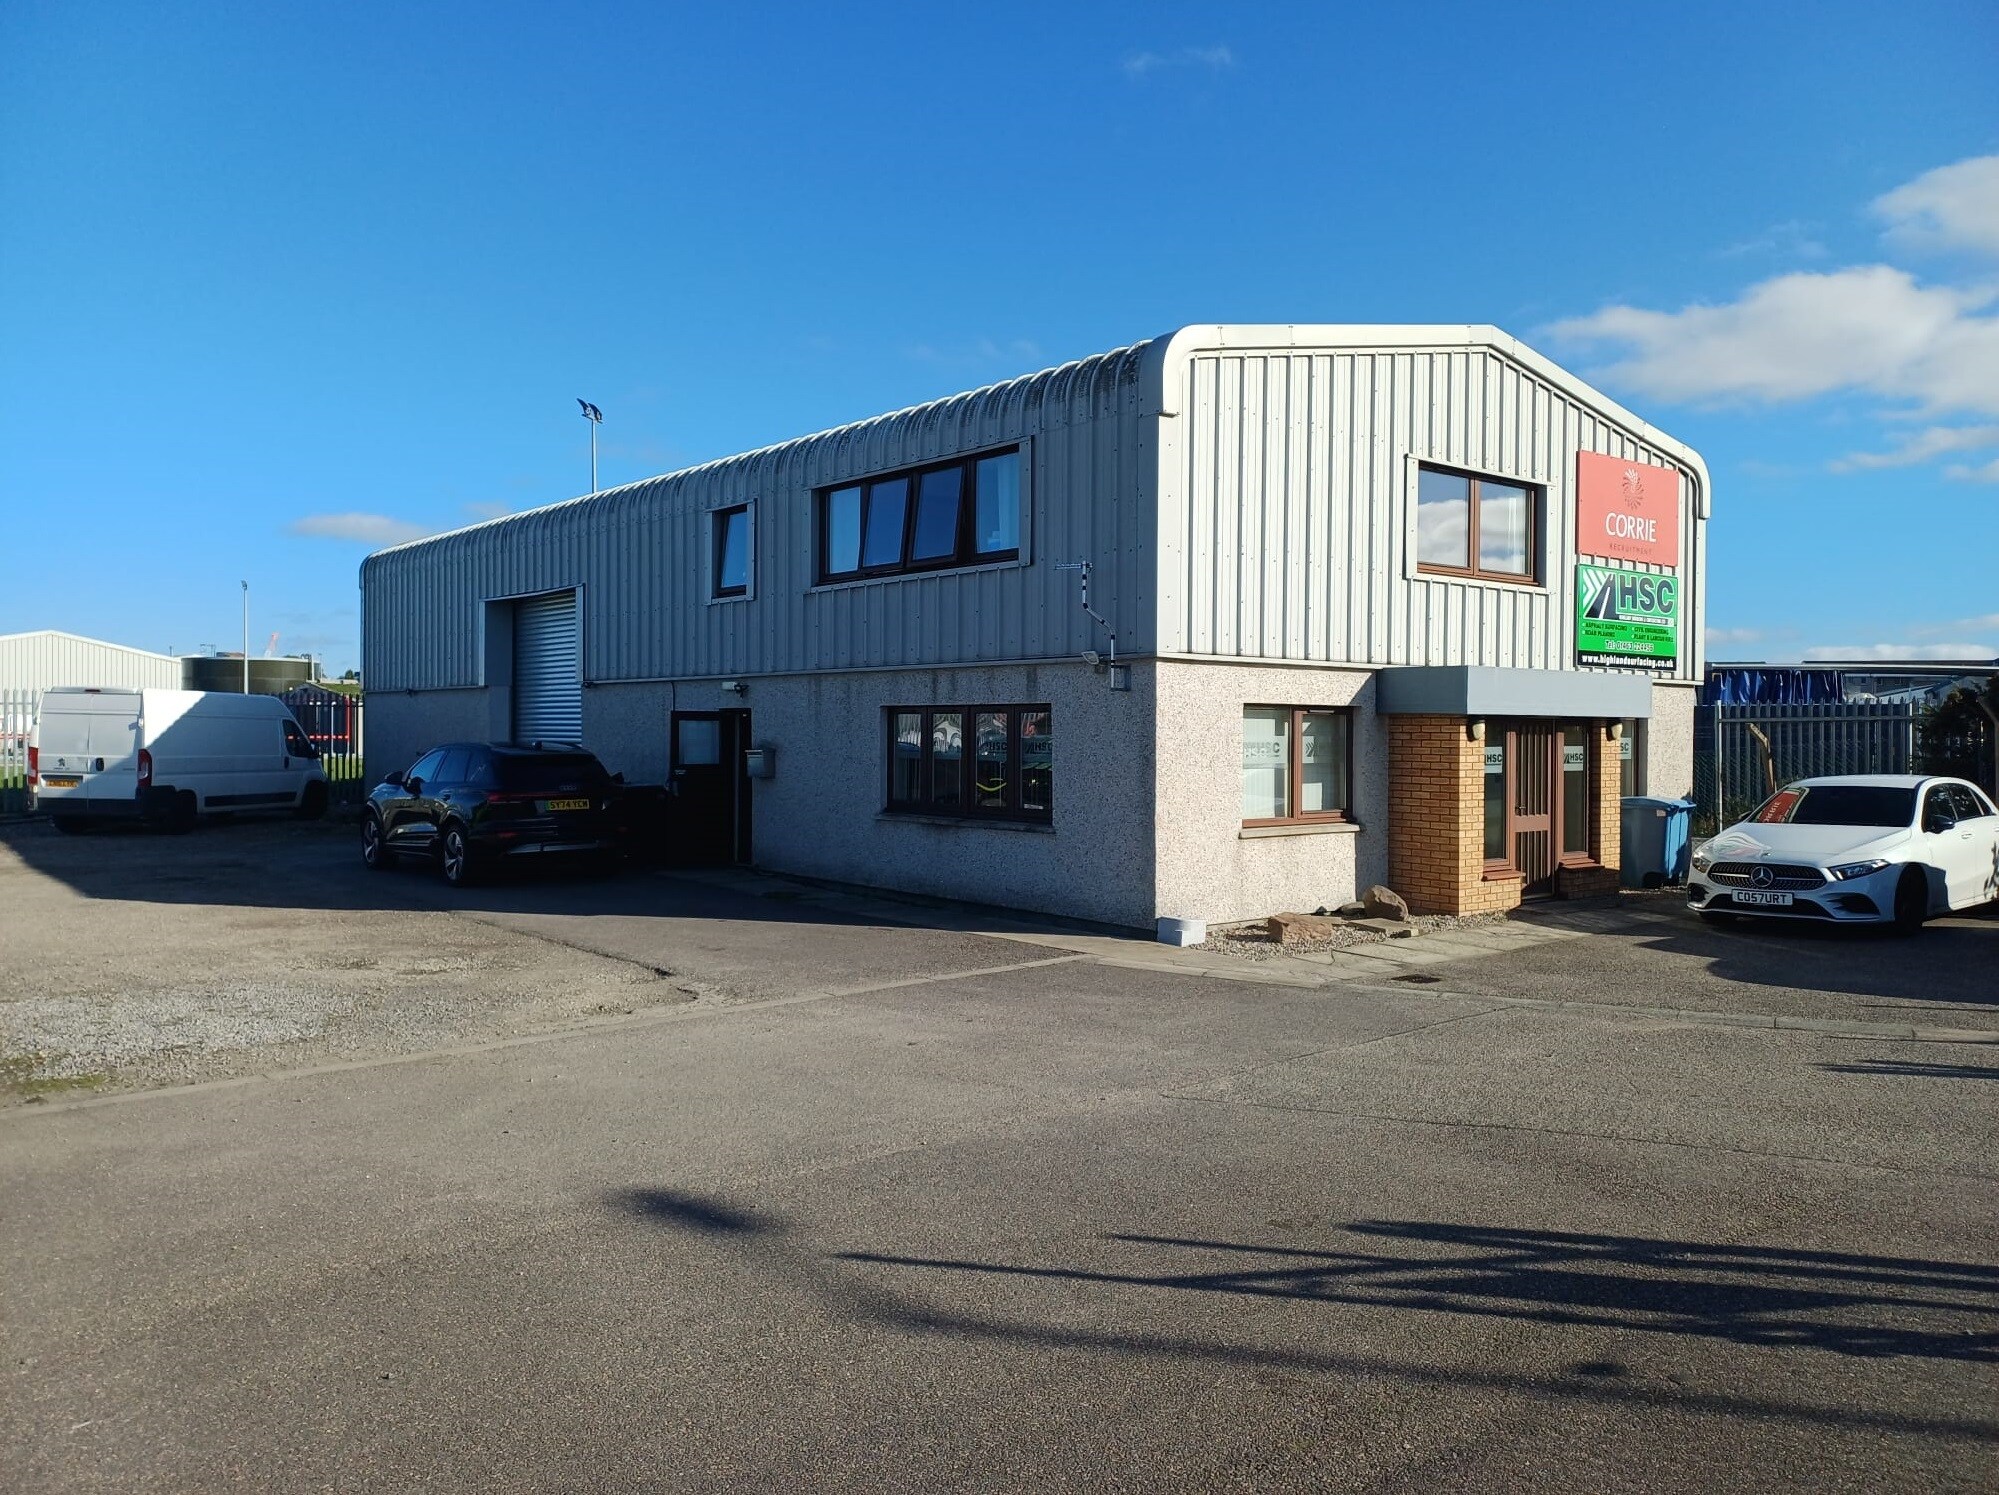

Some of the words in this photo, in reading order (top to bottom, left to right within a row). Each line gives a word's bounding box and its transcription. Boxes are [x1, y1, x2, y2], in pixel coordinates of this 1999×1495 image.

[1605, 512, 1657, 543] CORRIE
[1609, 542, 1653, 555] RECRUITMENT
[1618, 573, 1675, 615] HSC
[1581, 654, 1674, 669] www.highlandsurfacing.co.uk
[1486, 753, 1503, 763] HSC
[1569, 753, 1585, 762] HSC
